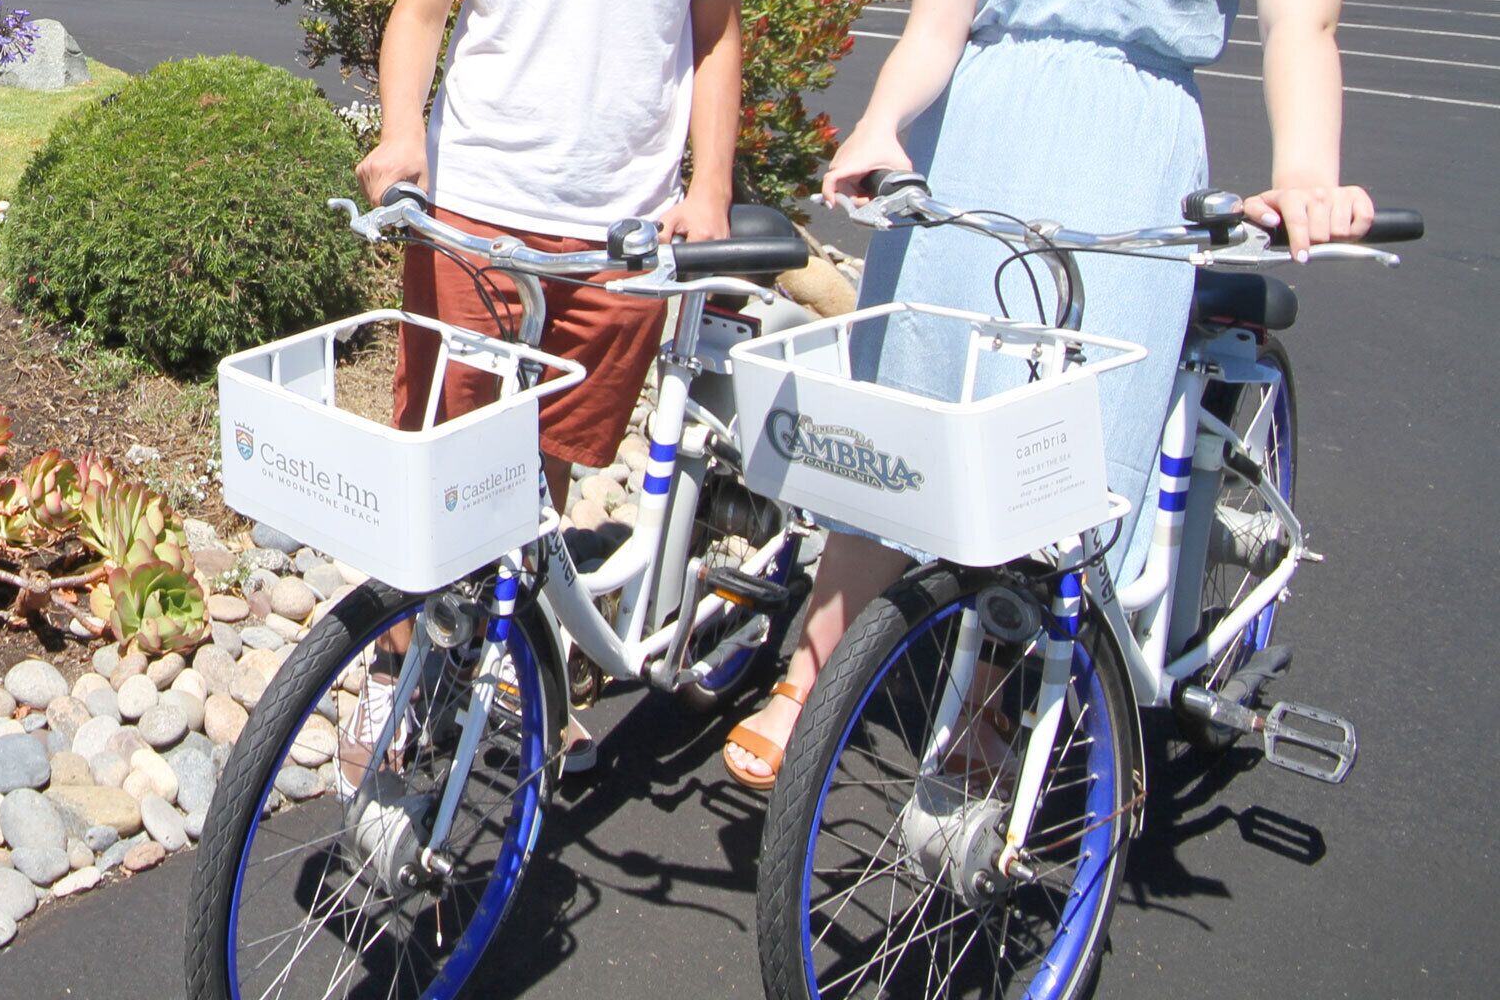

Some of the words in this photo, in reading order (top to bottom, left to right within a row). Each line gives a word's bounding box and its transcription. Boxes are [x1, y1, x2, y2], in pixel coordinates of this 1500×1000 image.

[765, 409, 924, 493] CAMBRIA
[1016, 432, 1067, 460] cambria
[260, 442, 331, 491] Castle
[337, 472, 380, 513] Inn
[461, 473, 502, 501] Castle
[504, 462, 526, 482] Inn
[805, 457, 881, 487] CALIFORNIA
[1016, 464, 1036, 478] PINES
[1046, 457, 1058, 468] THE
[261, 467, 274, 479] ON
[278, 475, 339, 509] MOONSTONE
[343, 504, 380, 527] BEACH
